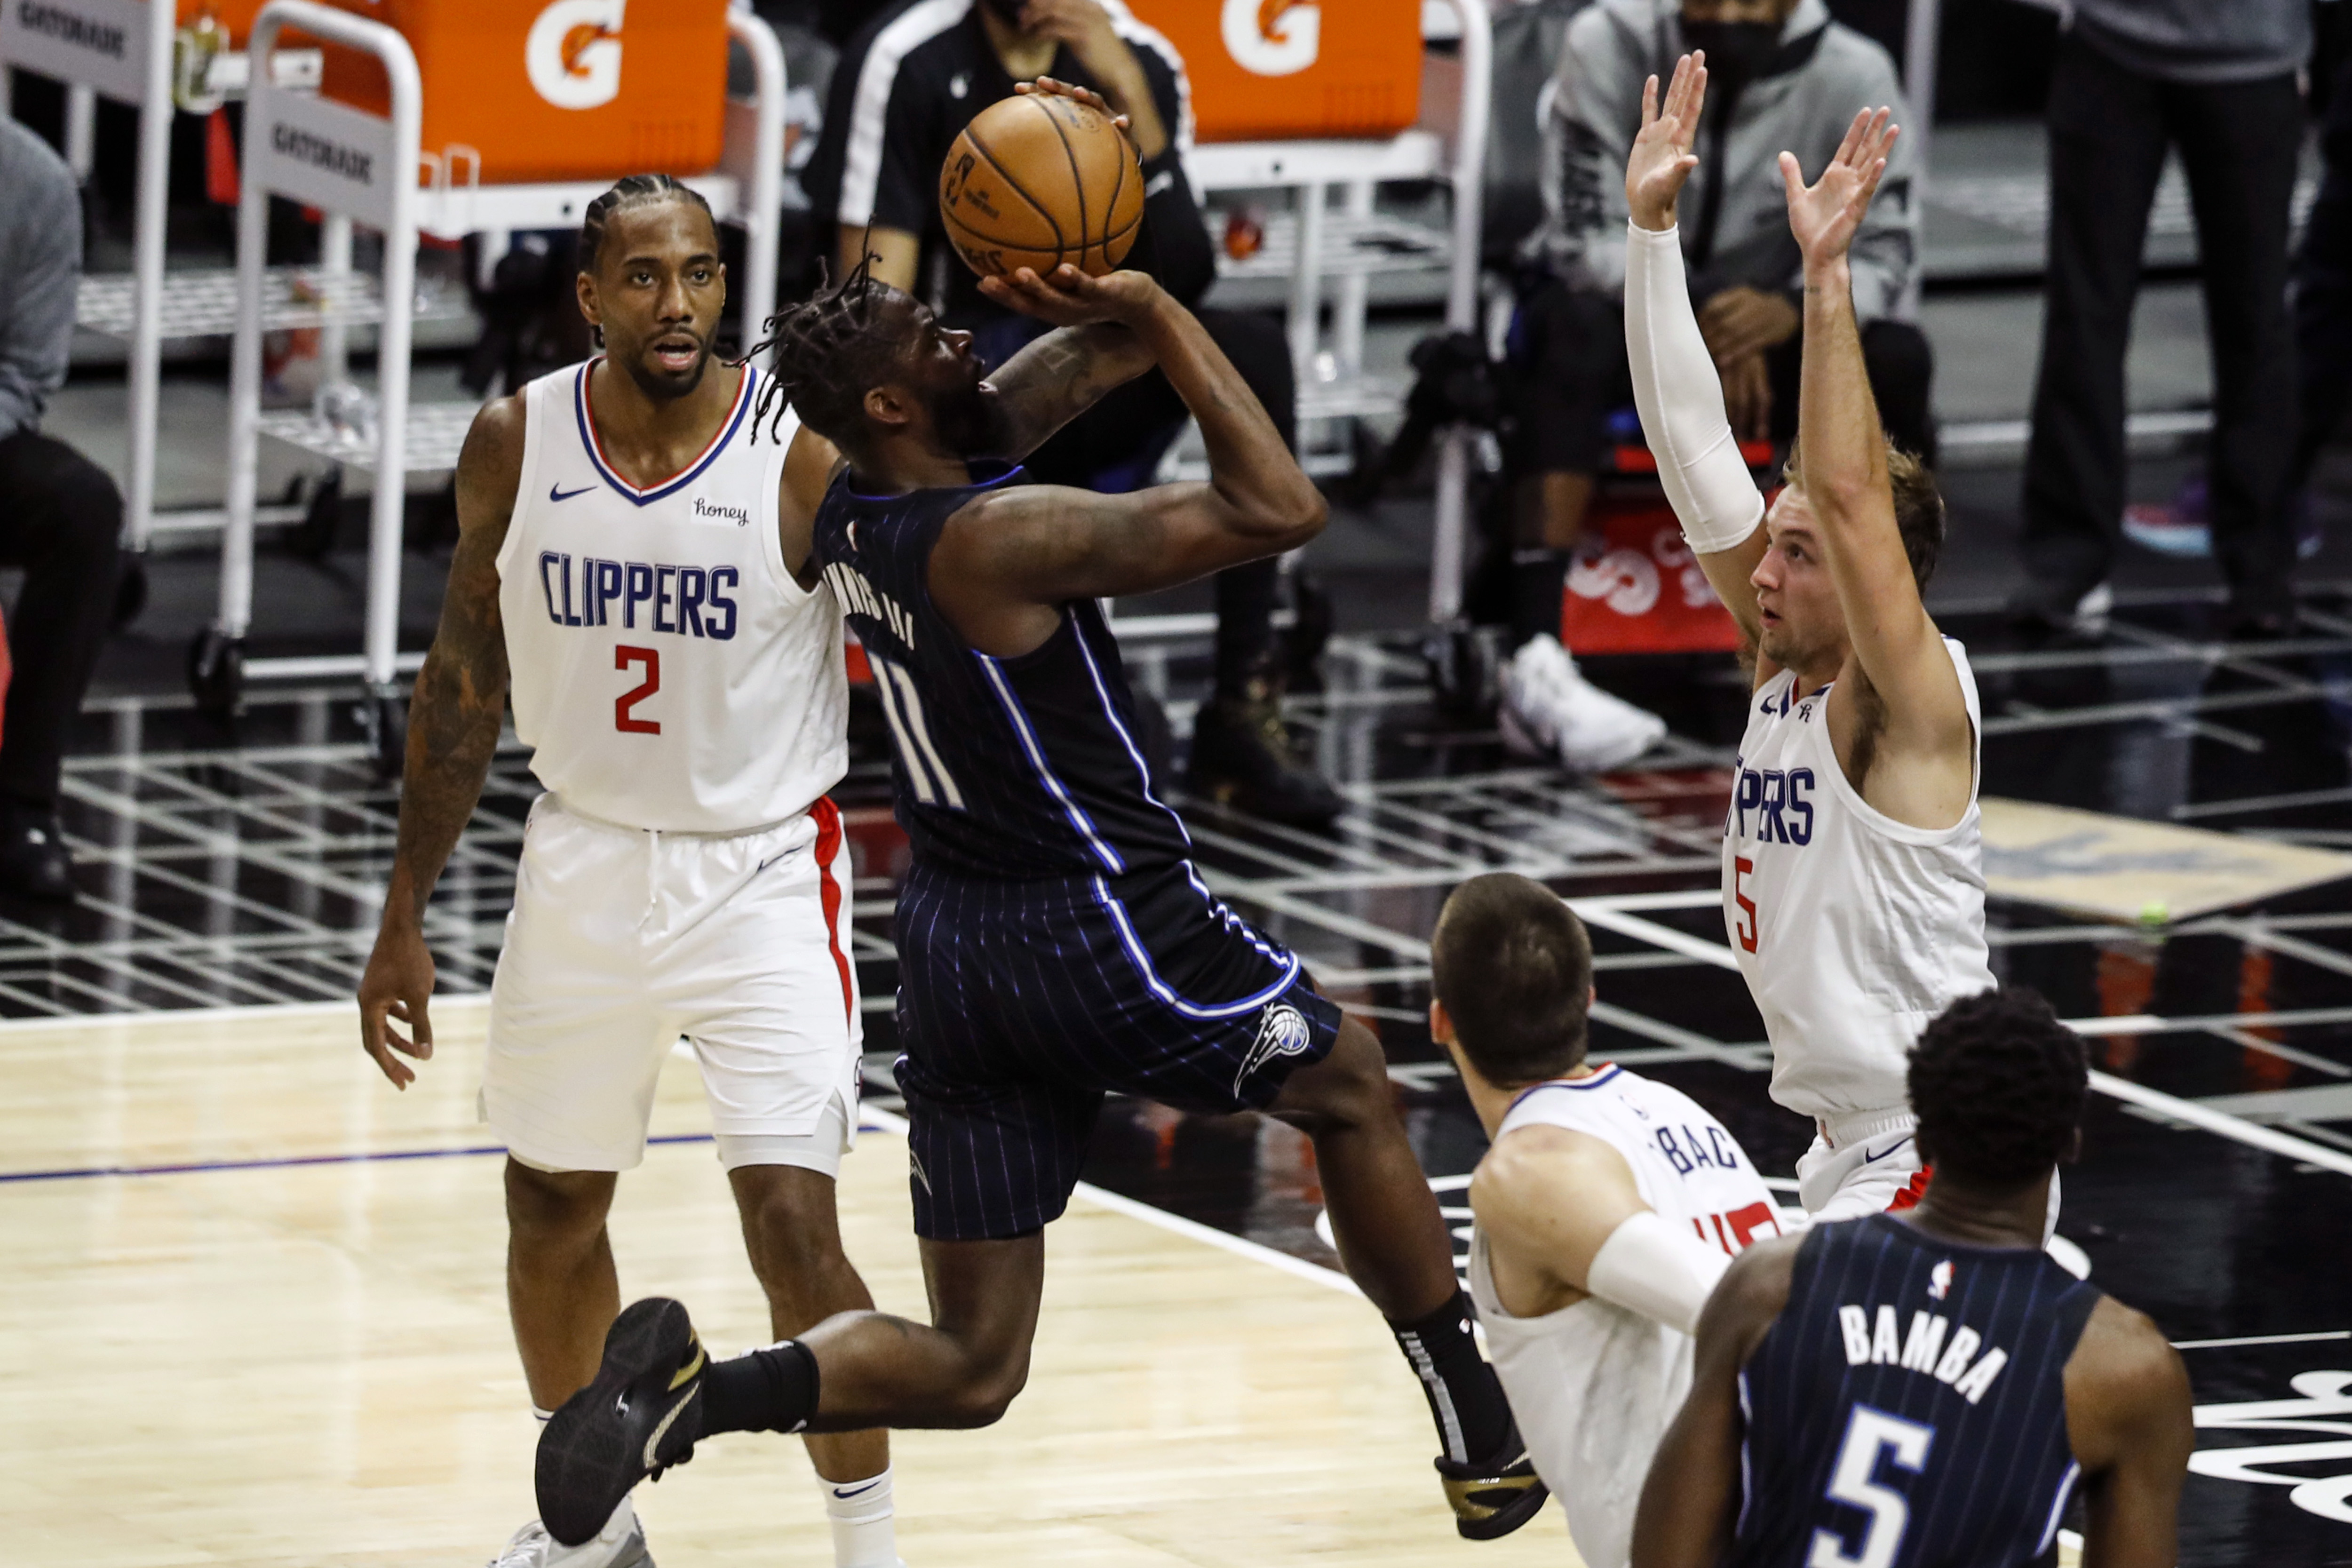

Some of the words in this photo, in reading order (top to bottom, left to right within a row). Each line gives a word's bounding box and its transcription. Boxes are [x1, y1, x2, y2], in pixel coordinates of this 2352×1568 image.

[525, 0, 627, 110] G
[693, 497, 749, 527] honey
[539, 550, 739, 641] CLIPPERS
[822, 562, 882, 621] NNIS
[615, 644, 661, 735] 2
[866, 649, 967, 812] 11
[1734, 855, 1757, 954] 5
[1648, 1123, 1738, 1175] BAC
[1838, 1304, 2009, 1406] BAMBA
[1804, 1401, 1937, 1568] 5
